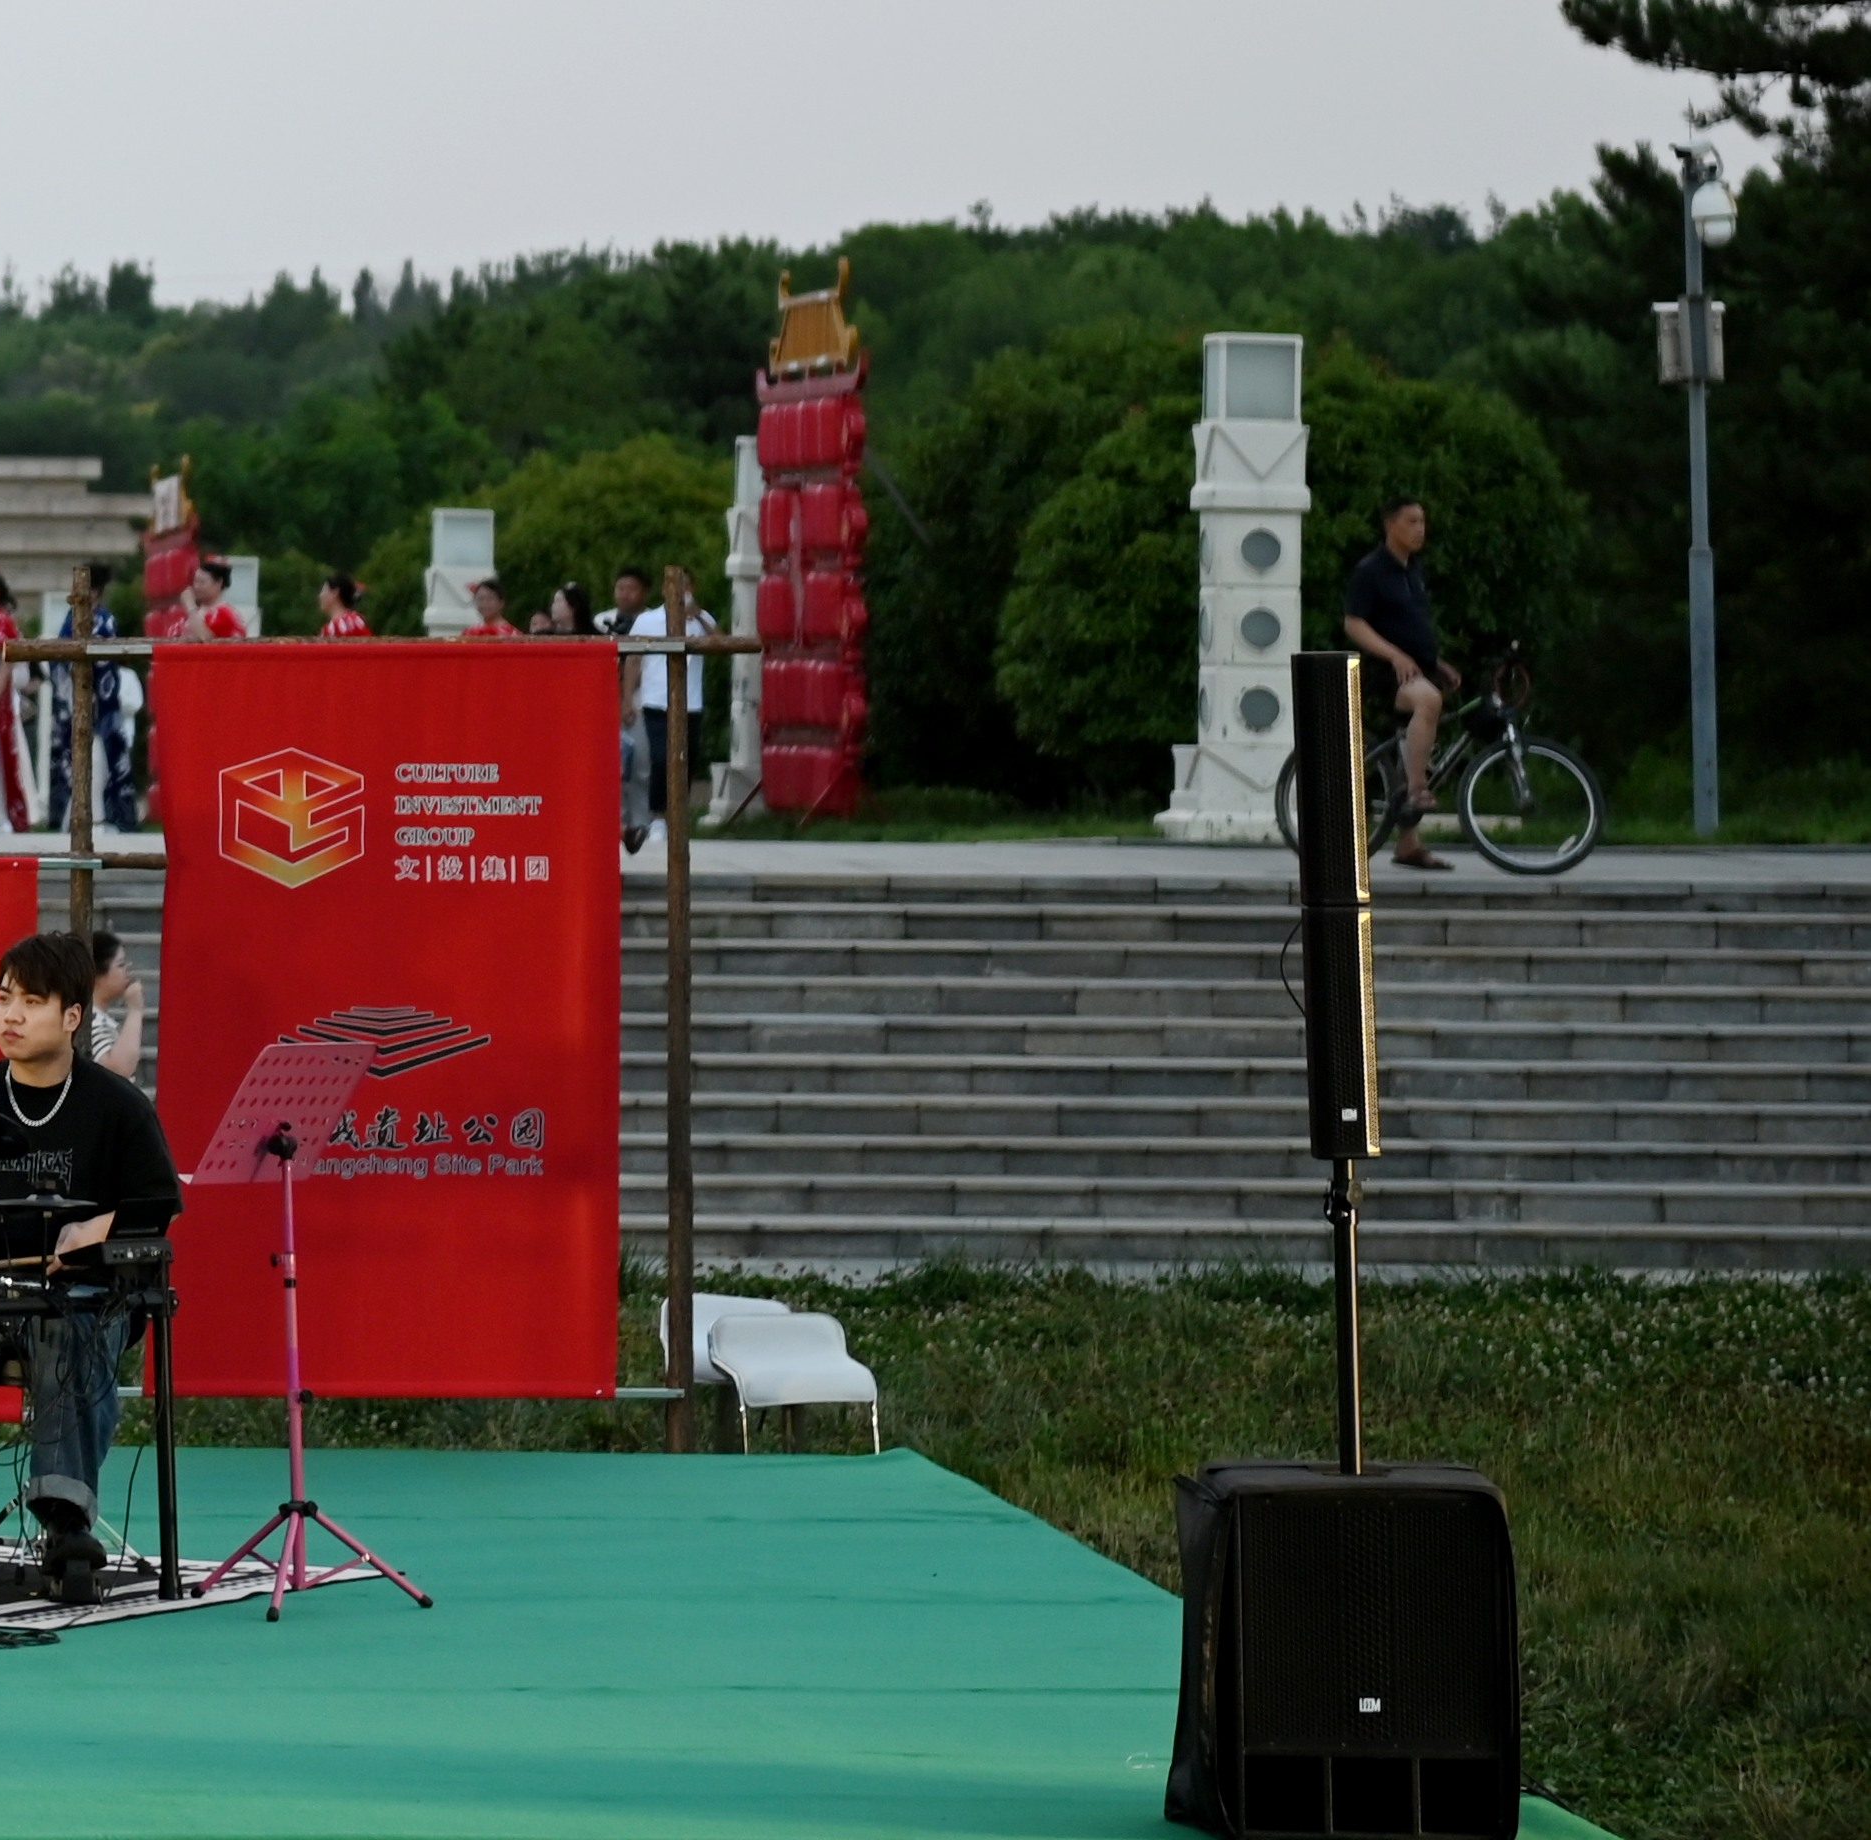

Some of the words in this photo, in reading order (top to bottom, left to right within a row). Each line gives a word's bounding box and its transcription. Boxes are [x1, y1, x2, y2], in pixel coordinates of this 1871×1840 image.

[394, 762, 501, 784] CULTURE
[394, 795, 543, 816] INVESTMENT
[394, 826, 476, 847] GROUP
[326, 1106, 545, 1152] 城遗址公园
[313, 1153, 428, 1179] angcheng
[434, 1153, 483, 1176] Site
[488, 1154, 544, 1177] Park
